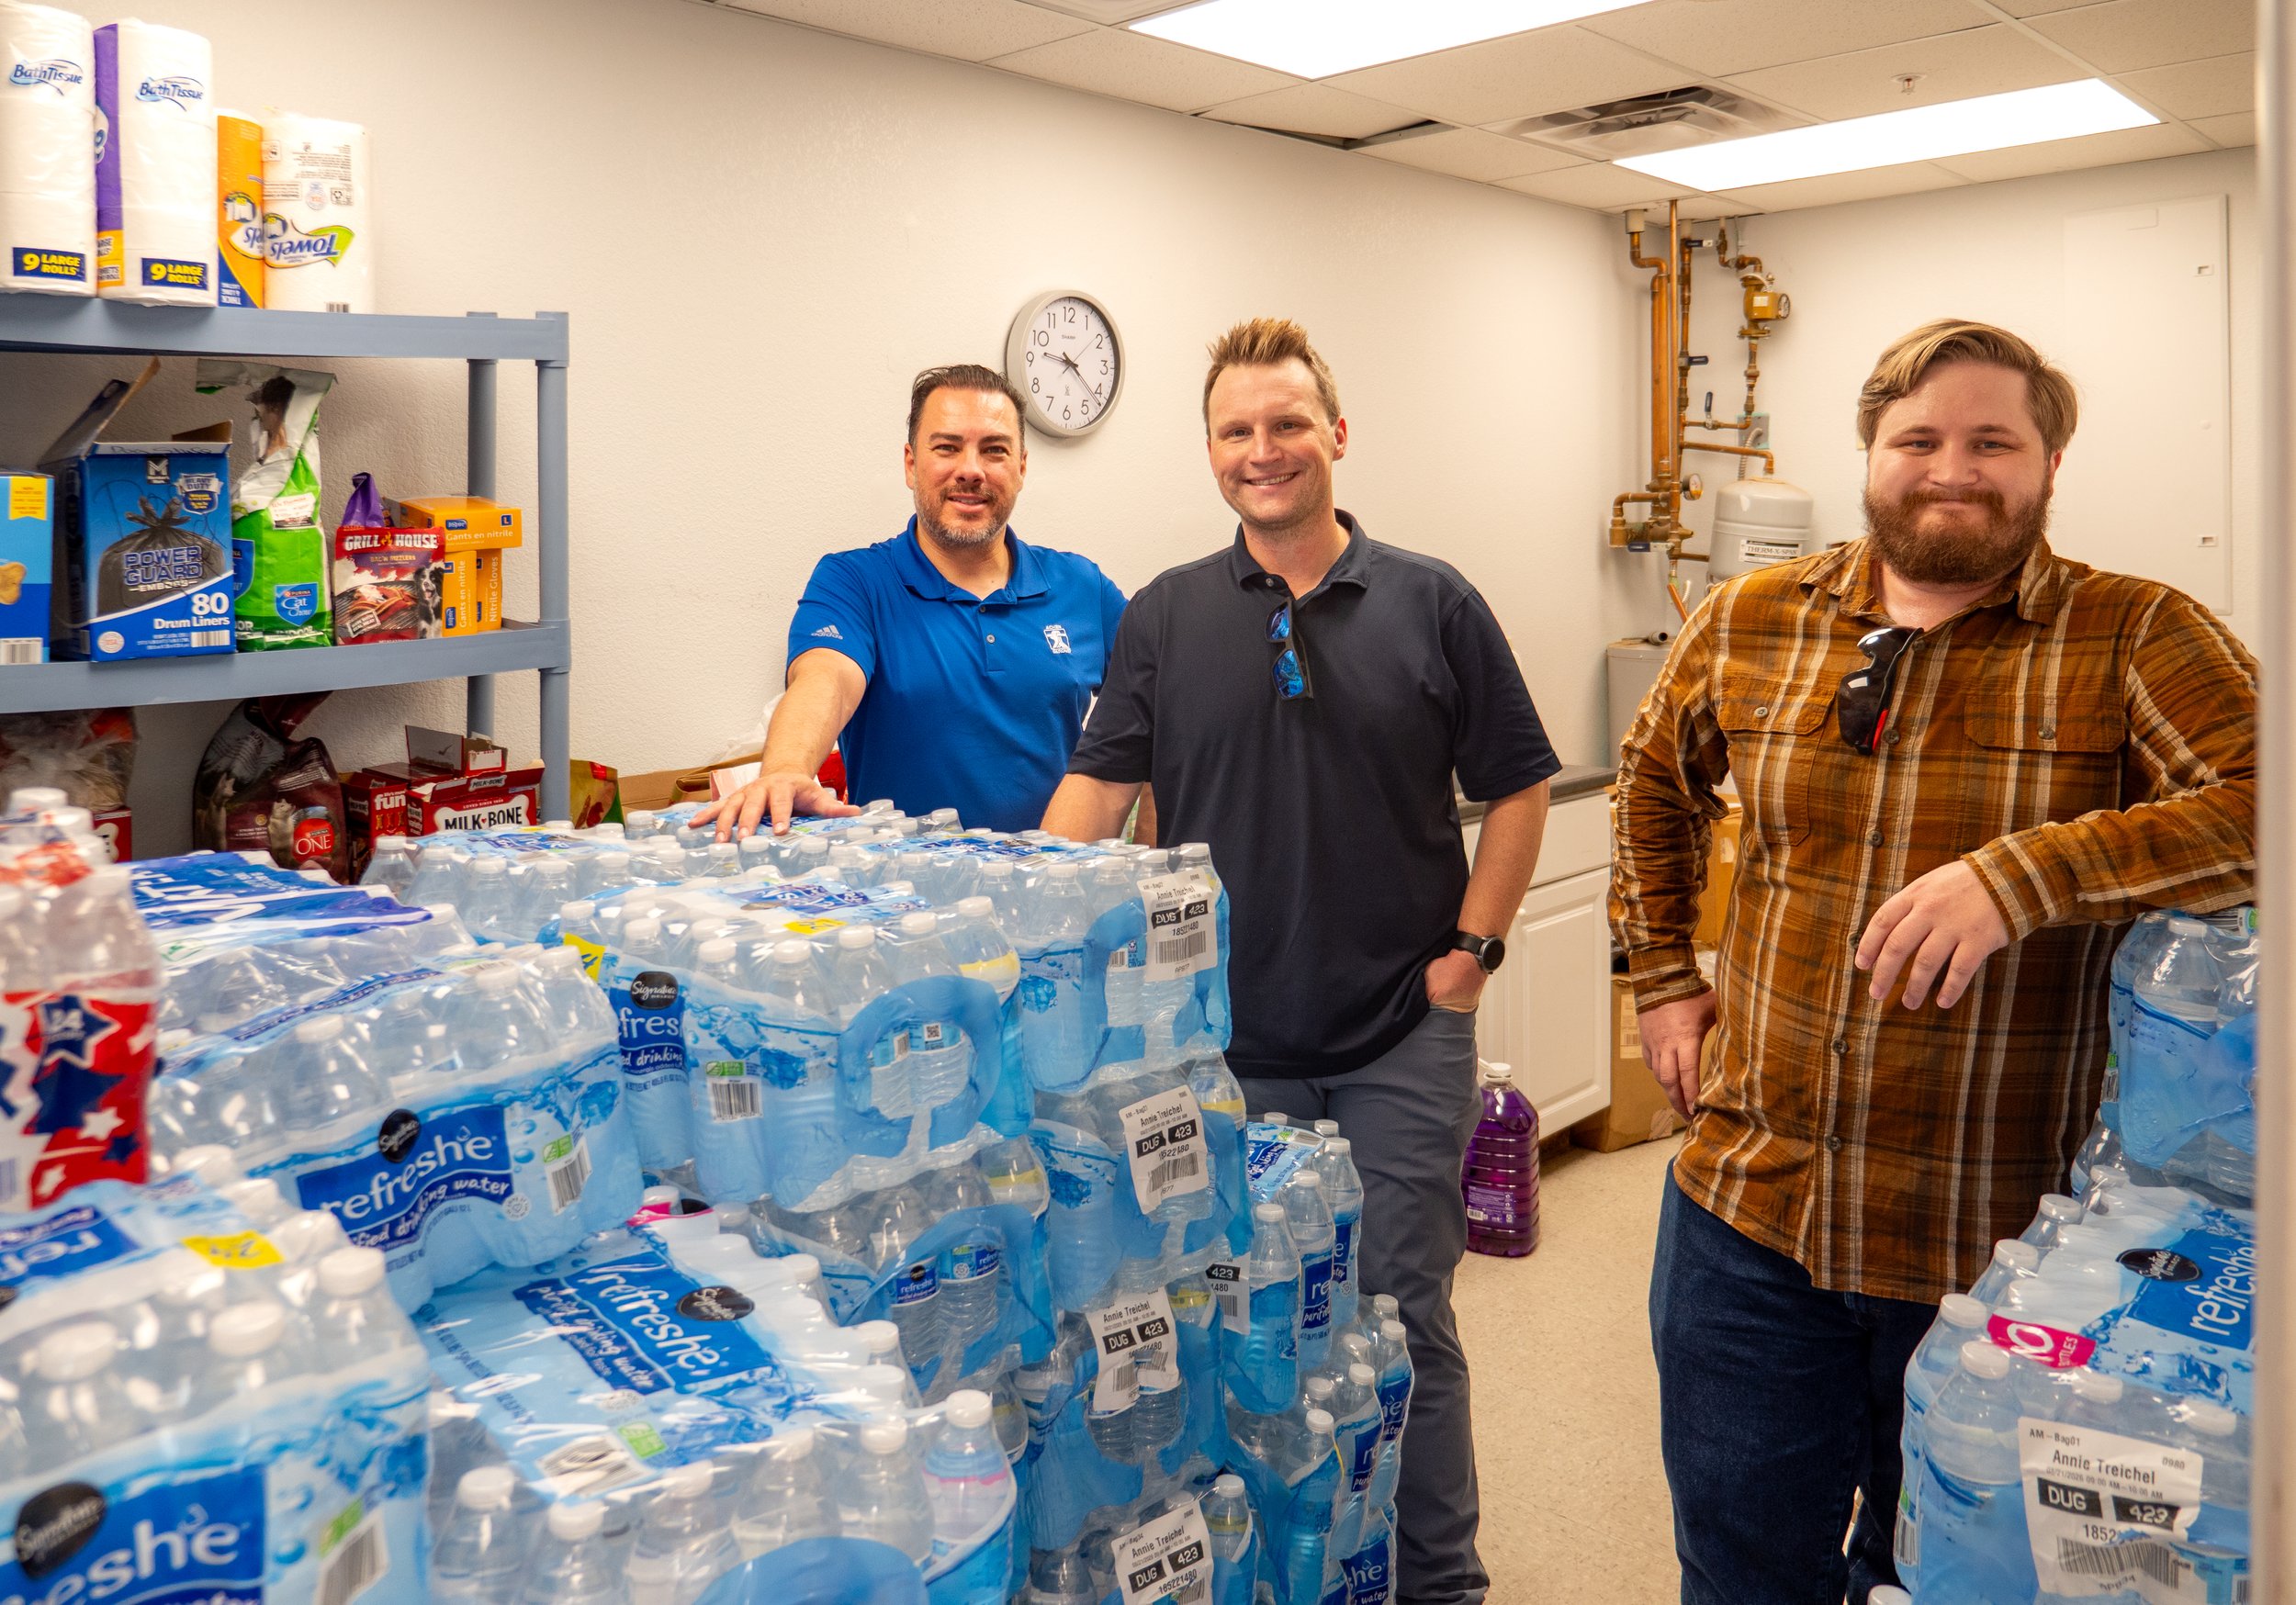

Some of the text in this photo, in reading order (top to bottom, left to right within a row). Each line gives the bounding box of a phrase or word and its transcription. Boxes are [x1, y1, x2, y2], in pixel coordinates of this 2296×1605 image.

[269, 233, 338, 261] Towels
[22, 253, 81, 272] 9 LARGE
[41, 264, 78, 275] ROLLS
[150, 263, 204, 281] 9 LARGE
[167, 274, 202, 285] ROLLS
[1047, 312, 1056, 329] 11
[1064, 306, 1075, 323] 12
[1032, 330, 1050, 347] 10
[1096, 333, 1103, 350] 2
[1026, 351, 1034, 367] 9
[1100, 359, 1109, 376] 3
[1031, 377, 1041, 394] 8
[1095, 383, 1103, 398] 4
[1046, 396, 1054, 411] 7
[1063, 405, 1071, 420] 6
[1081, 399, 1089, 415] 5
[344, 533, 439, 551] GRILL HOUSE
[446, 529, 513, 542] Gants en nitrile
[124, 545, 202, 569] POWER
[124, 561, 203, 586] GUARD
[458, 560, 467, 588] nitrile
[461, 589, 467, 600] en
[490, 556, 499, 623] Nitrile Gloves
[191, 591, 230, 616] 80
[282, 597, 308, 610] Cat
[153, 618, 191, 629] Drum
[193, 616, 231, 627] Liners
[811, 632, 844, 641] adidas
[375, 793, 406, 811] fun
[296, 834, 332, 856] ONE
[1157, 885, 1196, 901] Annie Treichel
[1155, 904, 1205, 925] DUG 423
[631, 981, 677, 1001] Signature
[636, 1047, 683, 1067] drinking
[1141, 1104, 1184, 1128] Annie Treichel
[1142, 1124, 1192, 1152] DUG 423
[453, 1175, 510, 1195] water
[1211, 1266, 1233, 1279] 423
[1104, 1300, 1151, 1323] Annie Treichel
[1109, 1322, 1164, 1349] DUG 423
[2030, 1428, 2186, 1471] AM Bag01 0980
[2053, 1449, 2155, 1485] Annie Treichel
[2109, 1481, 2121, 1491] AM
[2150, 1489, 2163, 1500] AM
[2047, 1484, 2168, 1524] DUG 423
[1131, 1525, 1185, 1558] Annie Treichel
[1135, 1546, 1199, 1588] DUG 423
[1158, 1568, 1198, 1594] 185221480
[1361, 1590, 1388, 1605] water
